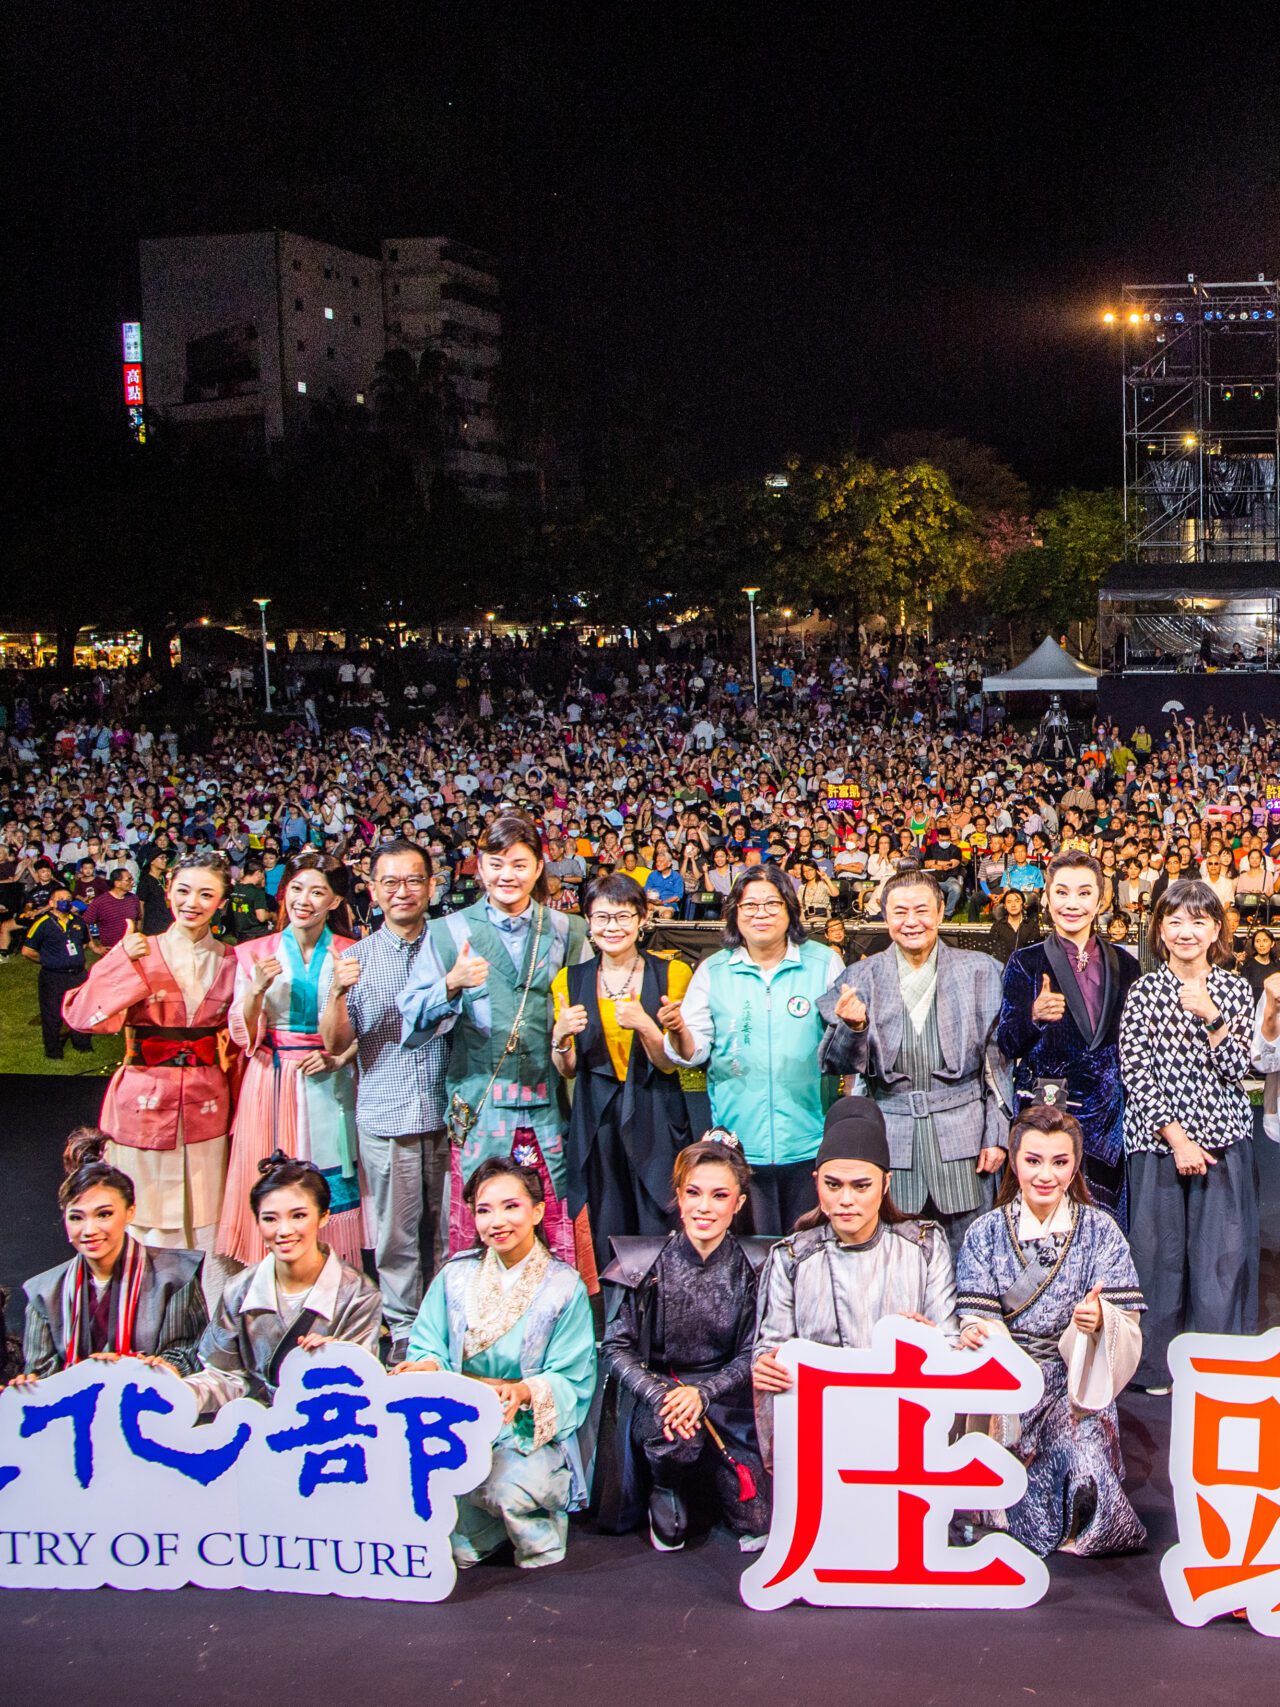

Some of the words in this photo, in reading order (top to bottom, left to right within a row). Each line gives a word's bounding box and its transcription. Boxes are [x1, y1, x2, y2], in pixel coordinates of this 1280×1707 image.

[126, 369, 141, 400] 高點
[0, 1365, 480, 1522] 化部
[764, 1339, 1026, 1588] 庄
[0, 1530, 93, 1566] TRY
[110, 1532, 179, 1567] OF
[197, 1532, 433, 1579] CULTURE
